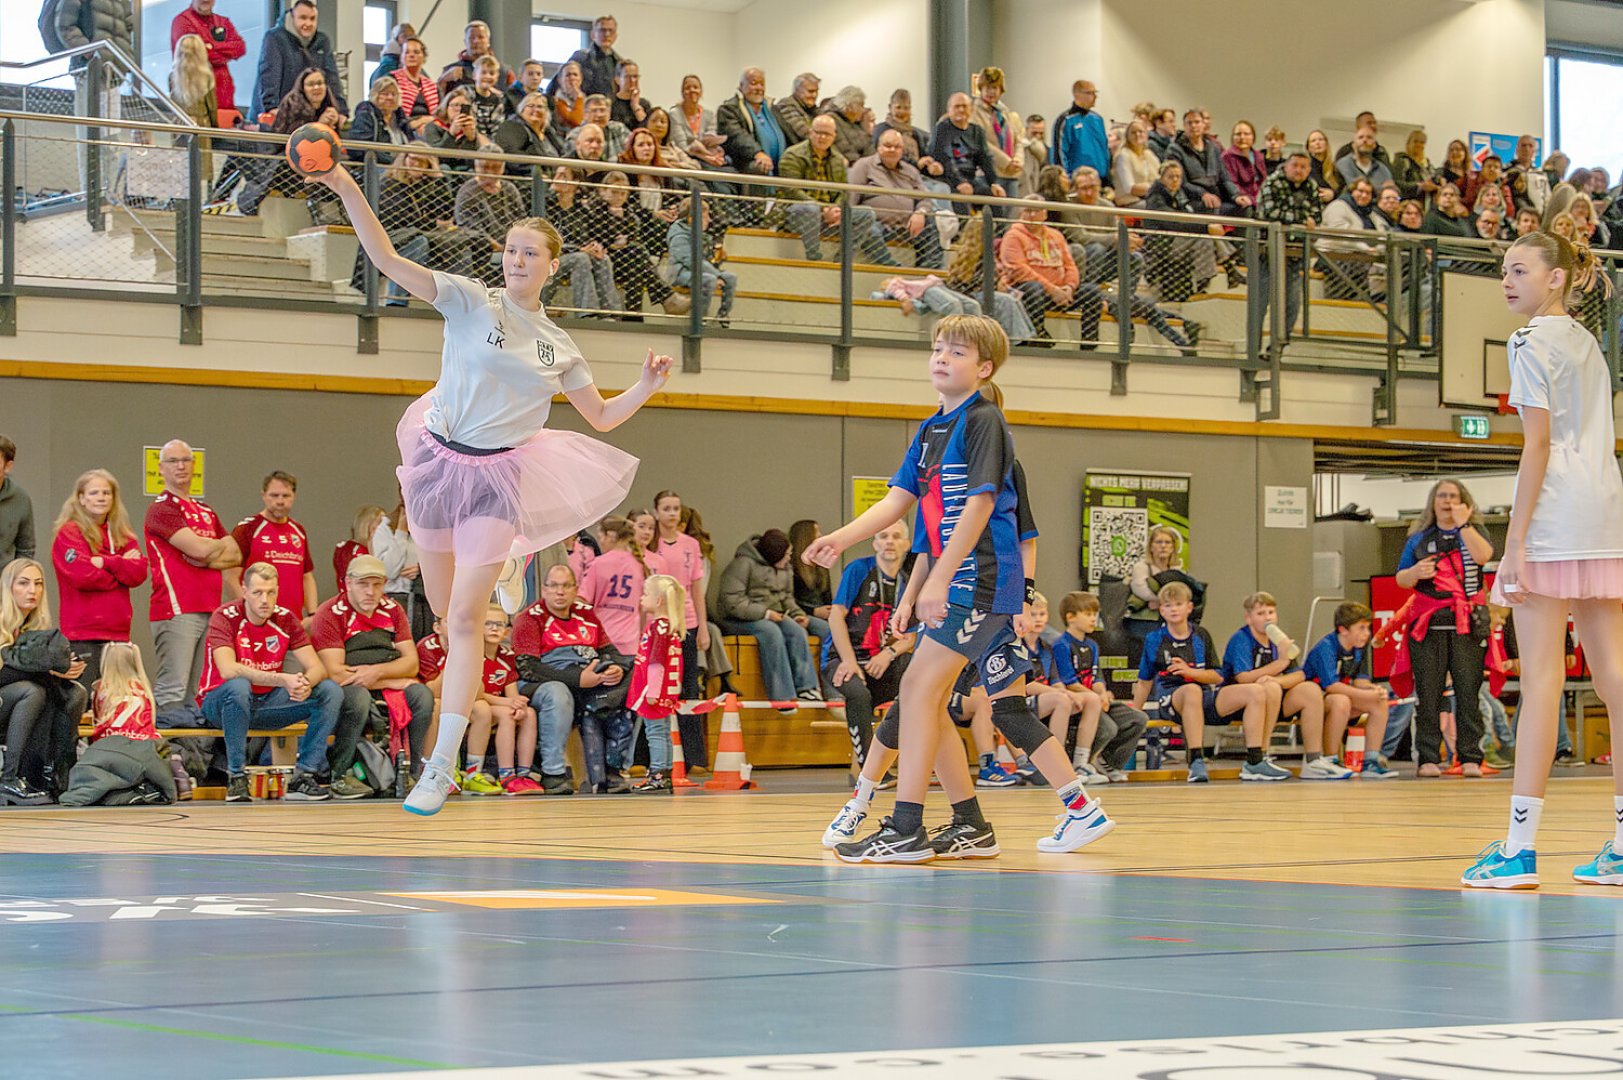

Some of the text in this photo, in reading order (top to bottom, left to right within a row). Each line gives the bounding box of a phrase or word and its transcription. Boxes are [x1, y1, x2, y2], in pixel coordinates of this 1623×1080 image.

[486, 332, 505, 349] LK
[278, 535, 288, 543] 5
[606, 574, 633, 599] 15
[253, 642, 263, 652] 7
[110, 695, 142, 728] 7
